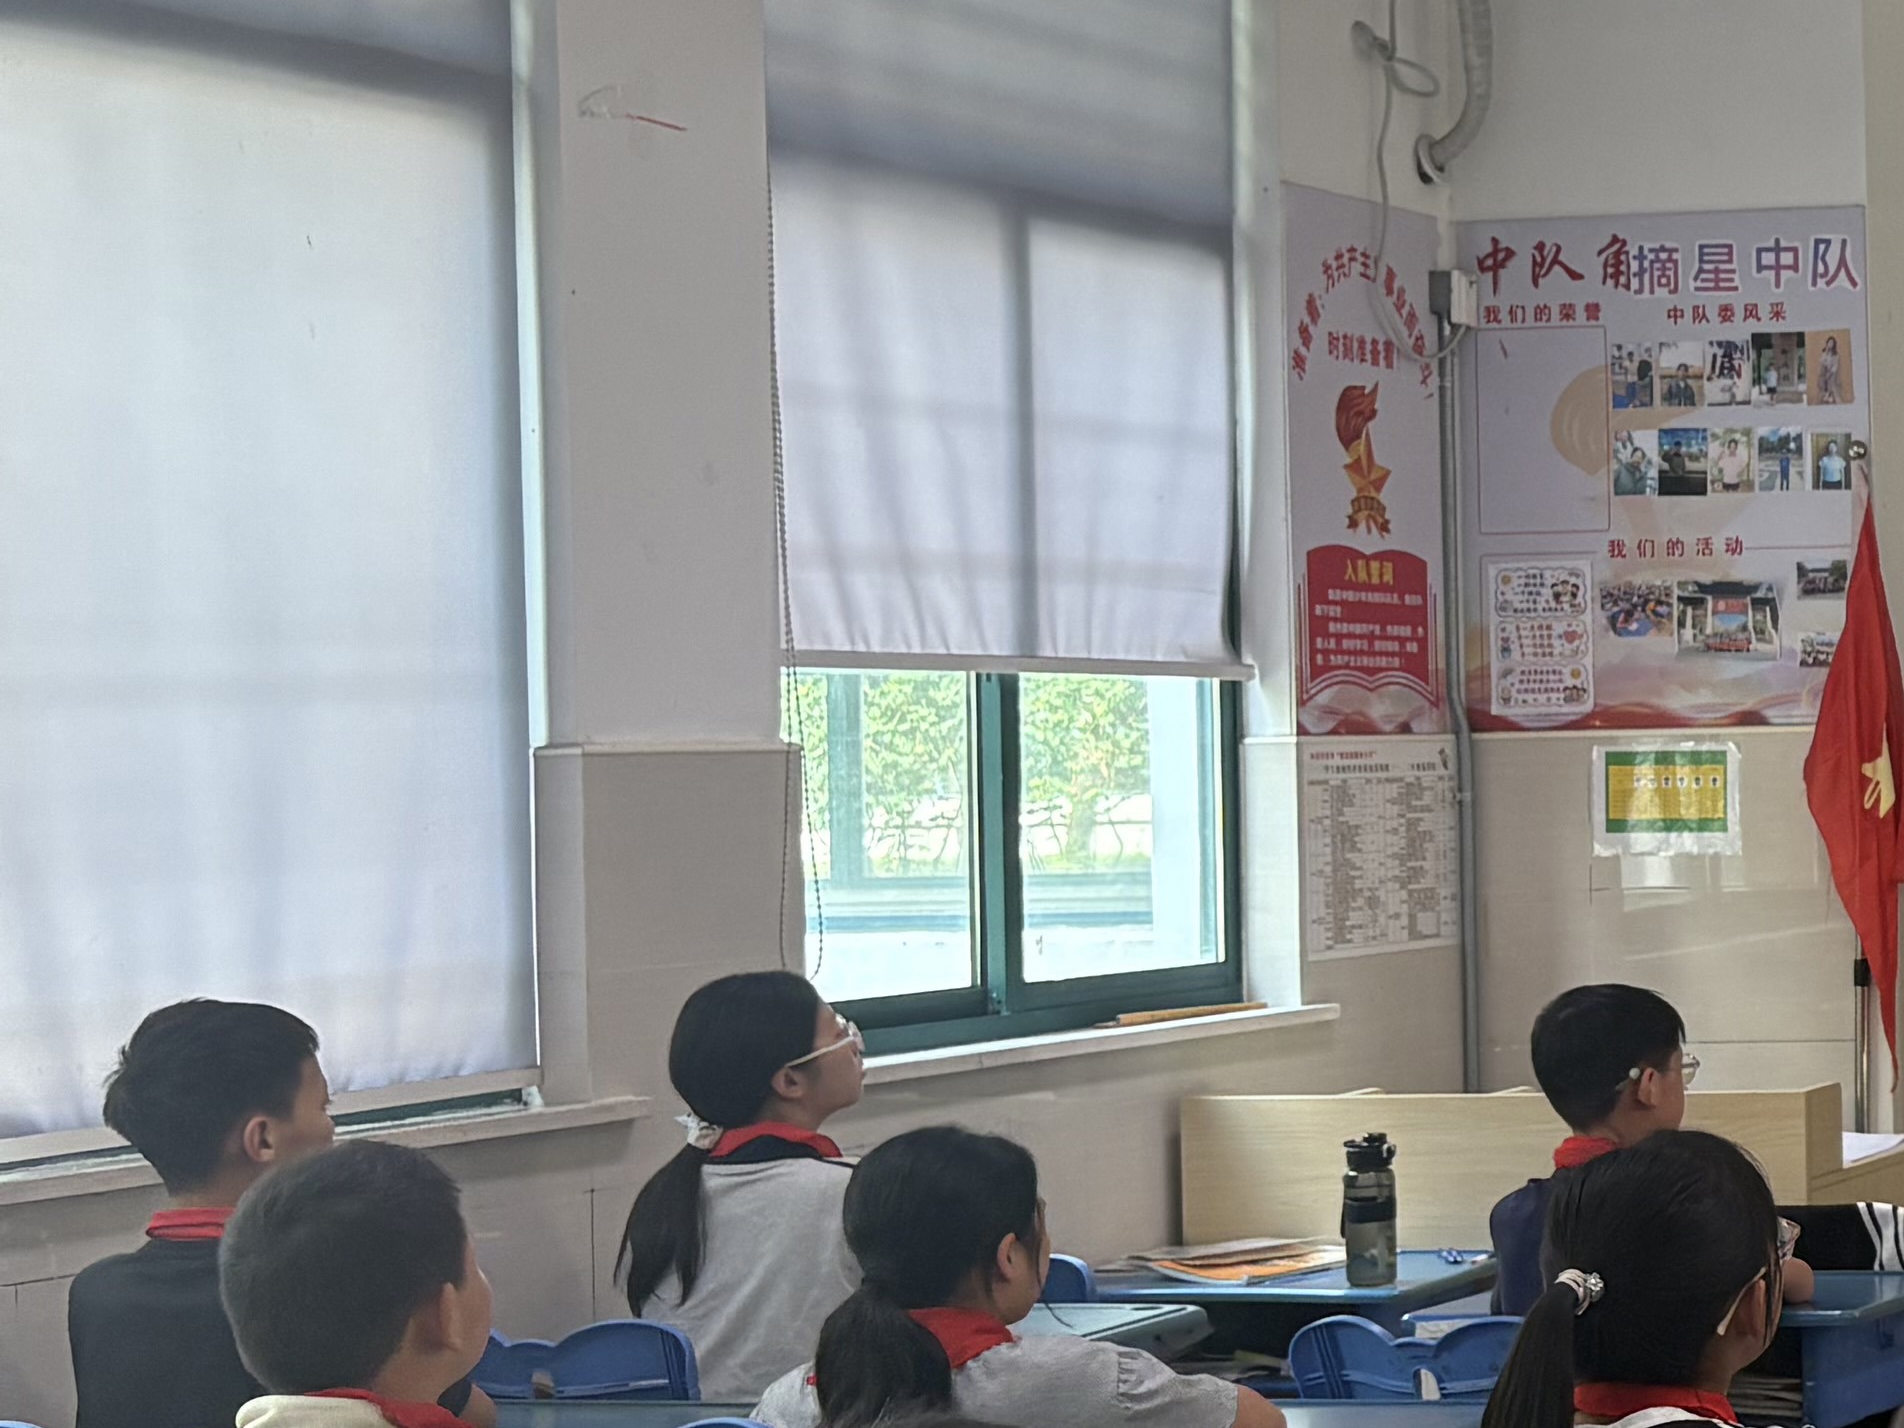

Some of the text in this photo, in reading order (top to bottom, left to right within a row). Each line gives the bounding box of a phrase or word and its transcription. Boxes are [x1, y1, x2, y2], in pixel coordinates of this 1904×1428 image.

[1476, 234, 1632, 298] 中队角
[1633, 237, 1860, 296] 摘星中队
[1483, 301, 1602, 325] 我们的荣誉
[1666, 302, 1787, 326] 中队委风采
[1607, 536, 1744, 559] 我们的活动
